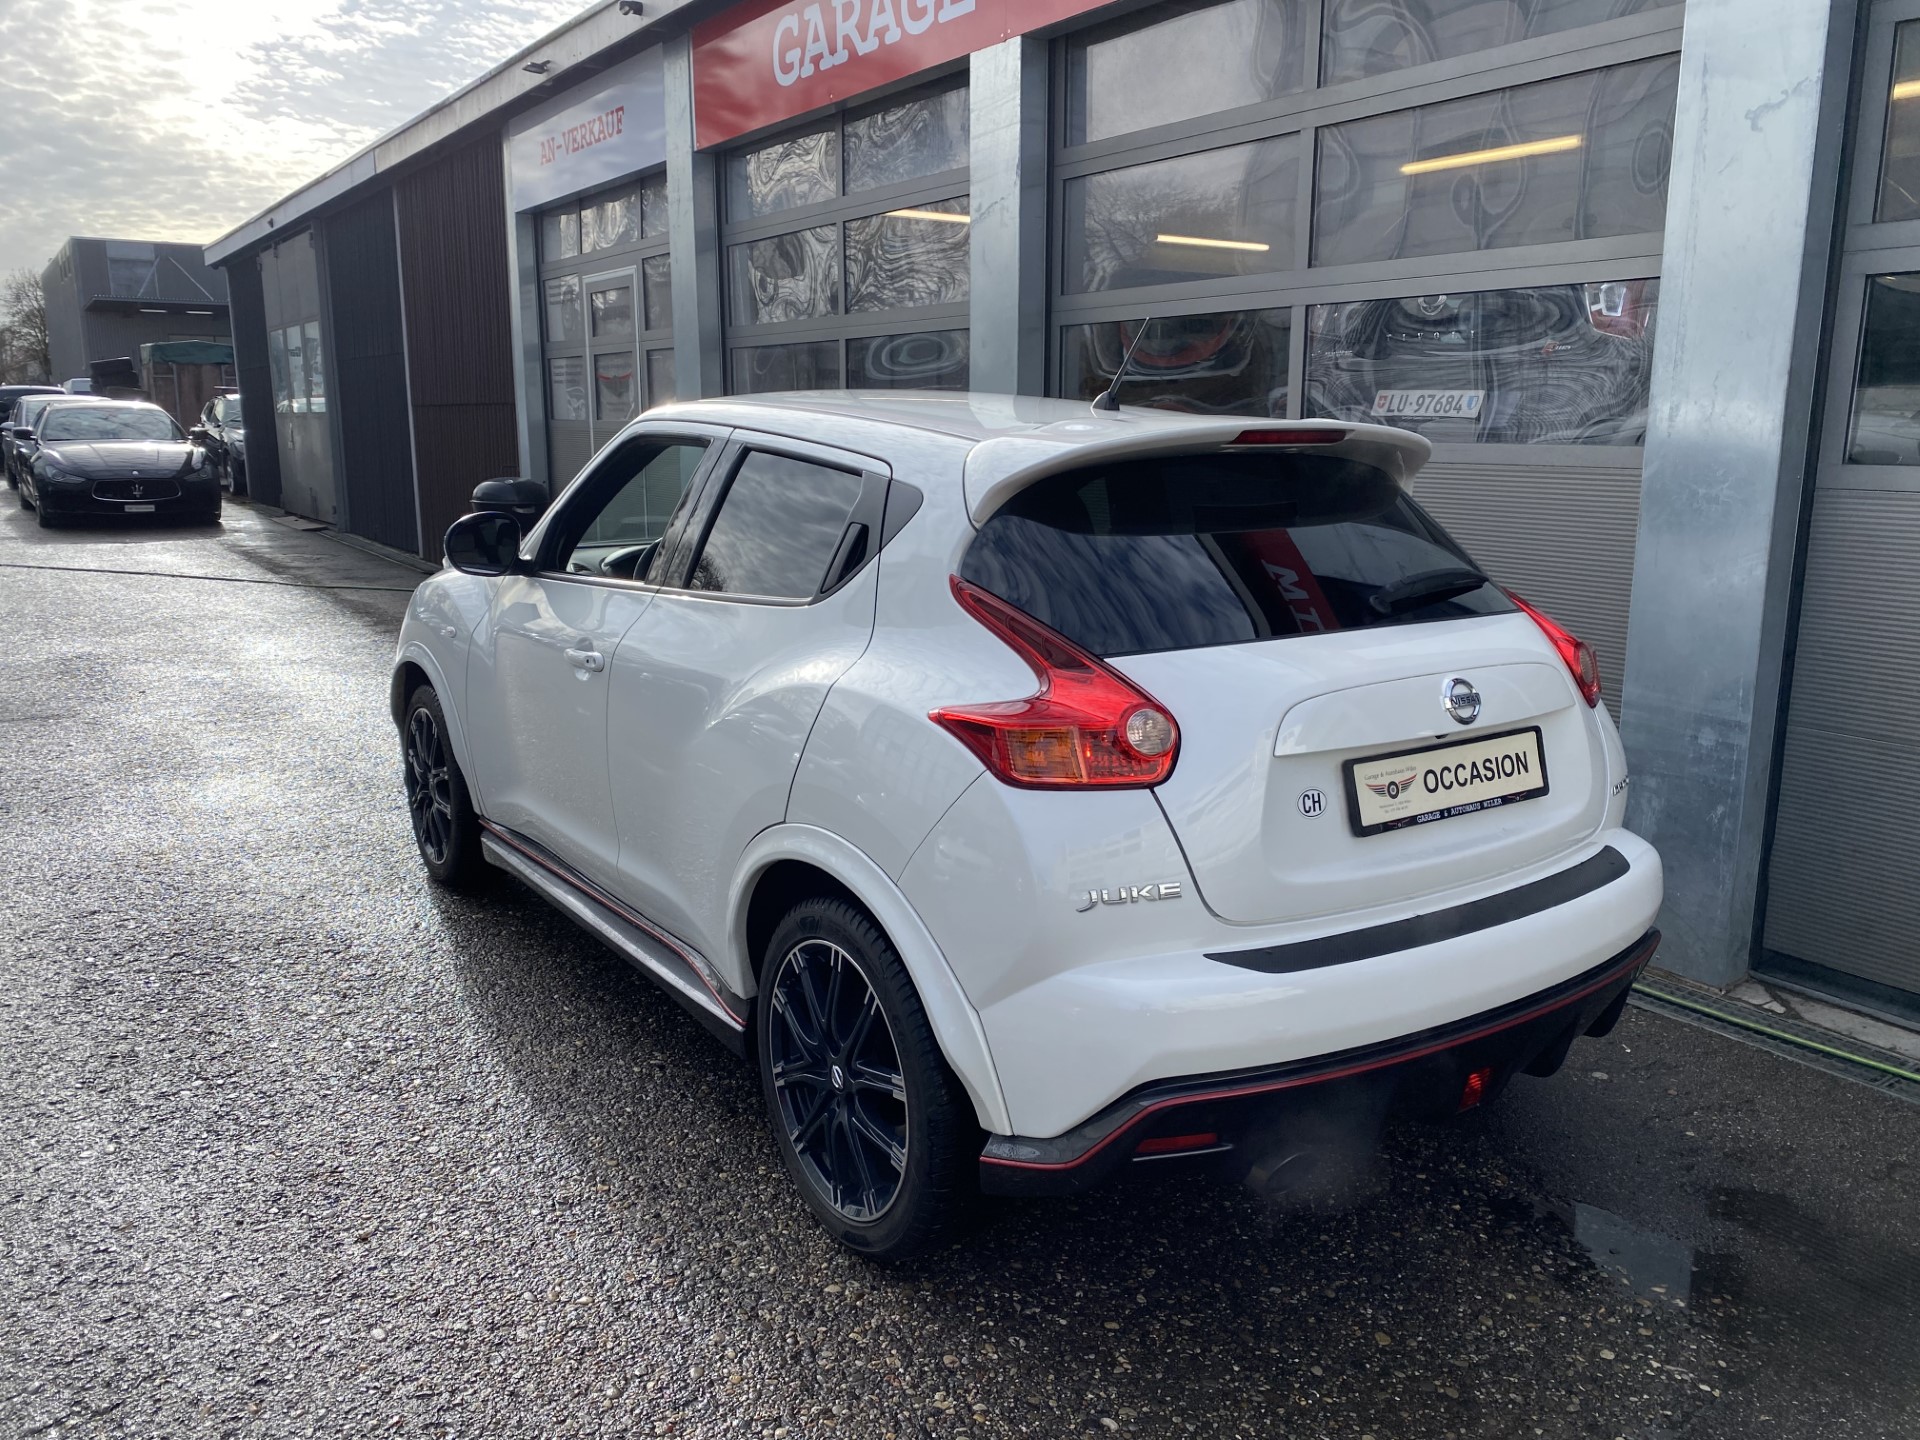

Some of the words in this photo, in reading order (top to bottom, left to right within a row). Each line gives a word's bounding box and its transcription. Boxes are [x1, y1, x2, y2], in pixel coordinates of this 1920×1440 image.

[773, 0, 976, 87] GARA
[540, 105, 625, 166] AN-VERKAUF
[1451, 693, 1480, 706] NISSAN
[1423, 751, 1529, 794] OCCASION
[1302, 792, 1322, 814] CH
[1416, 811, 1441, 823] GARAGE
[1450, 802, 1481, 816] AUTOHAUS
[1483, 798, 1503, 809] WILER
[1076, 882, 1183, 913] JUKE
